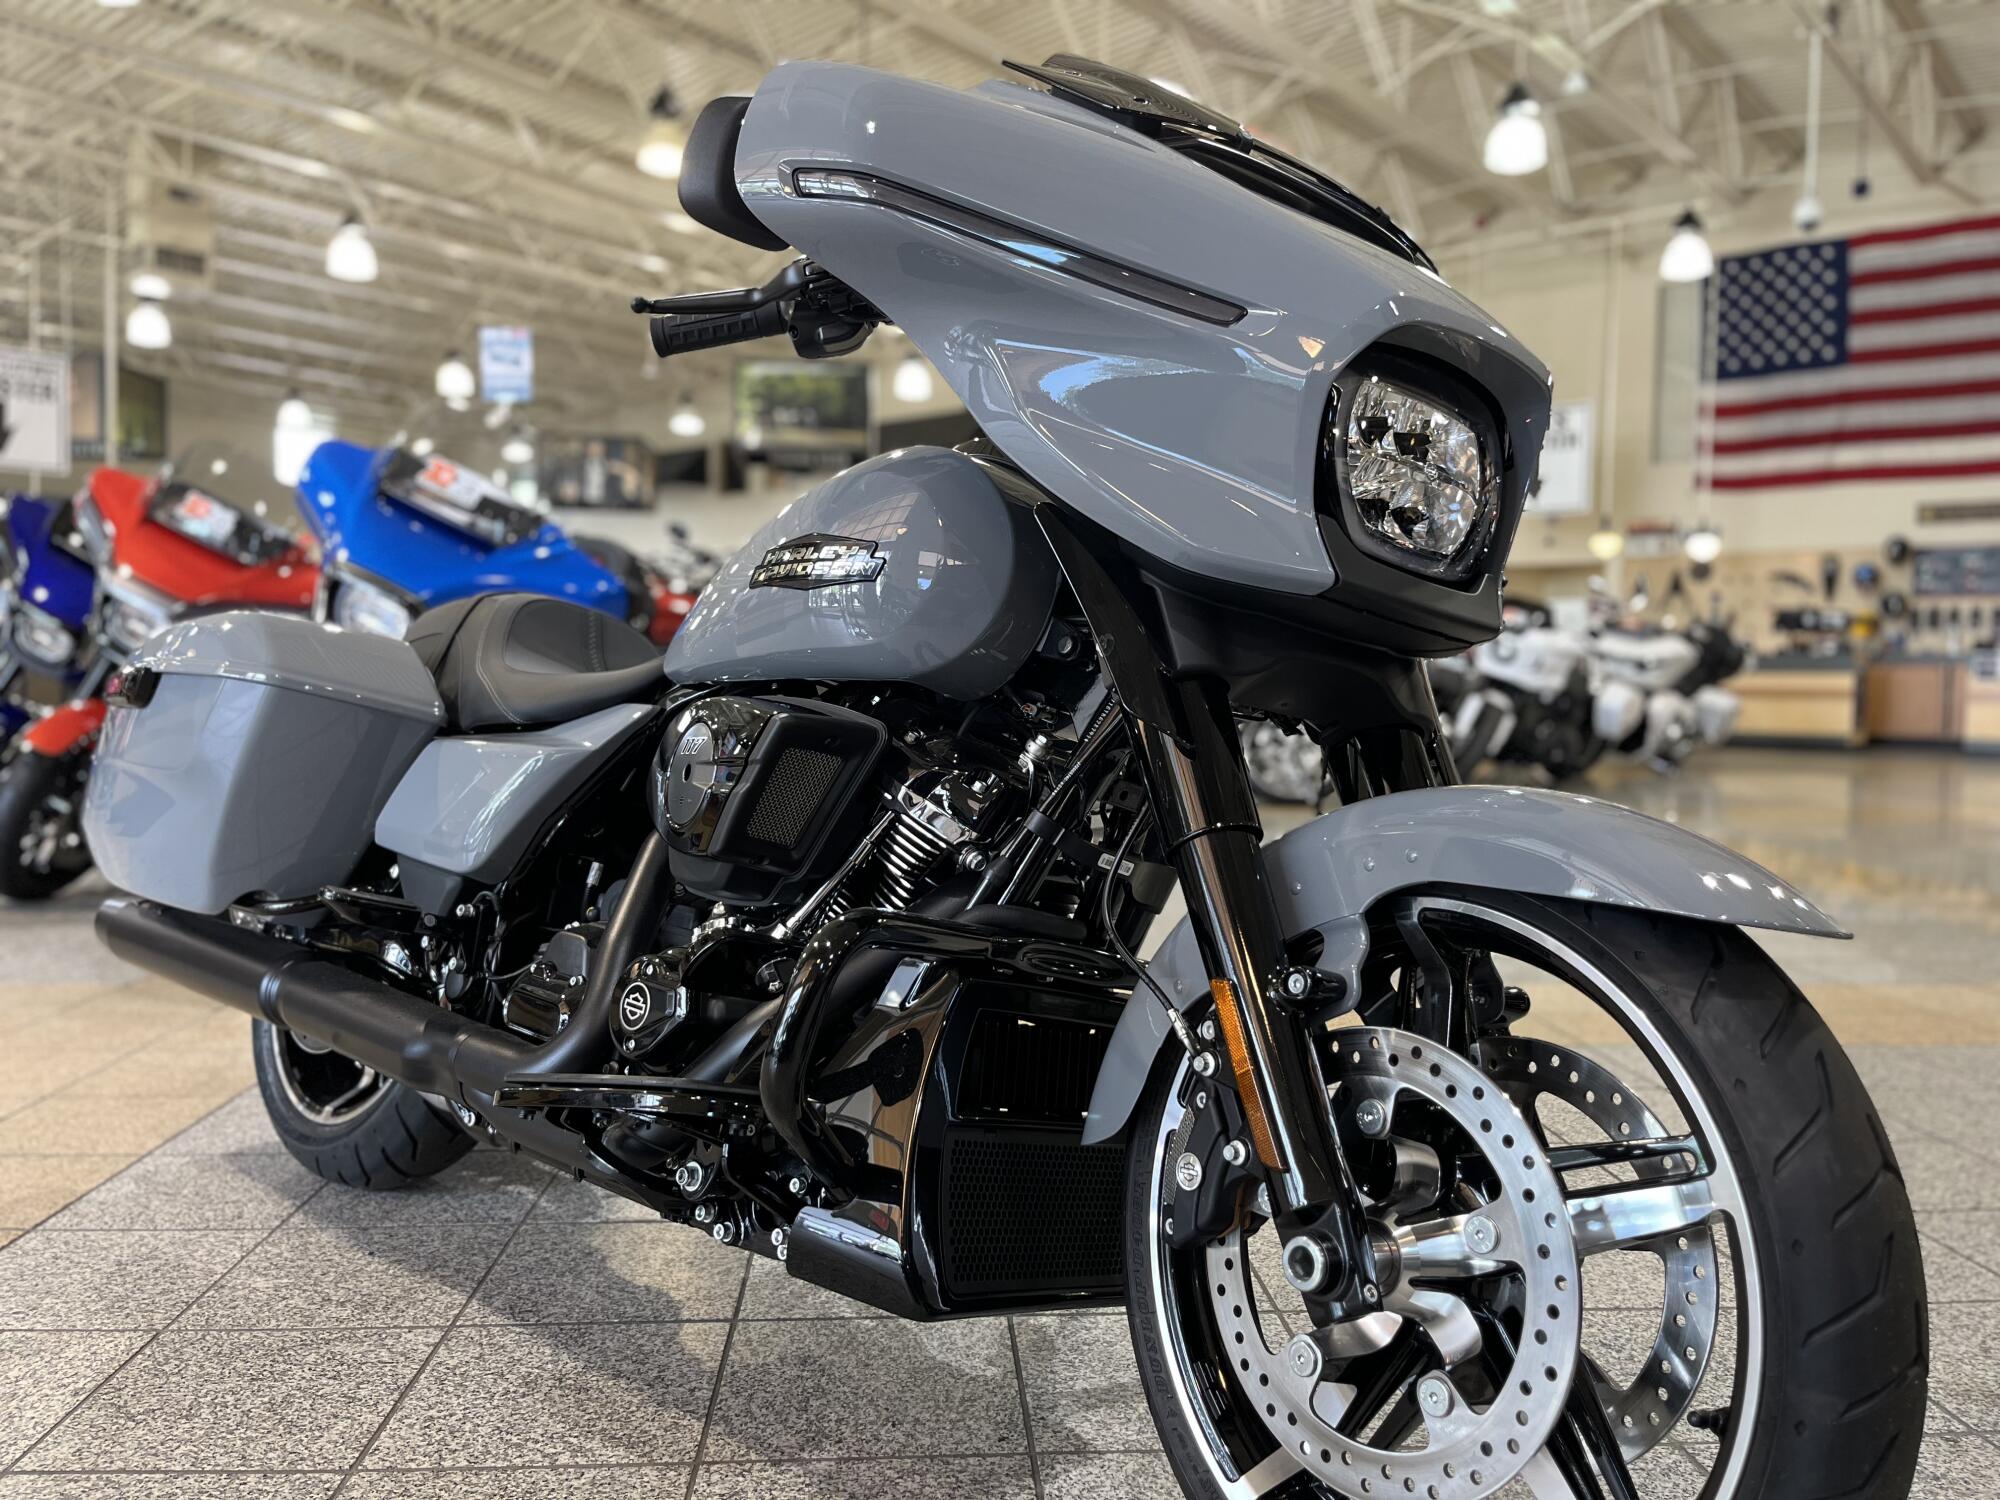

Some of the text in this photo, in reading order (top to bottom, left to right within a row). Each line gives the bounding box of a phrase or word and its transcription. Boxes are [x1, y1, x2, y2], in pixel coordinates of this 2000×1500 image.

[752, 560, 876, 582] DAVIDSON
[680, 736, 708, 754] 117
[1135, 1276, 1169, 1393] DUNLOP
